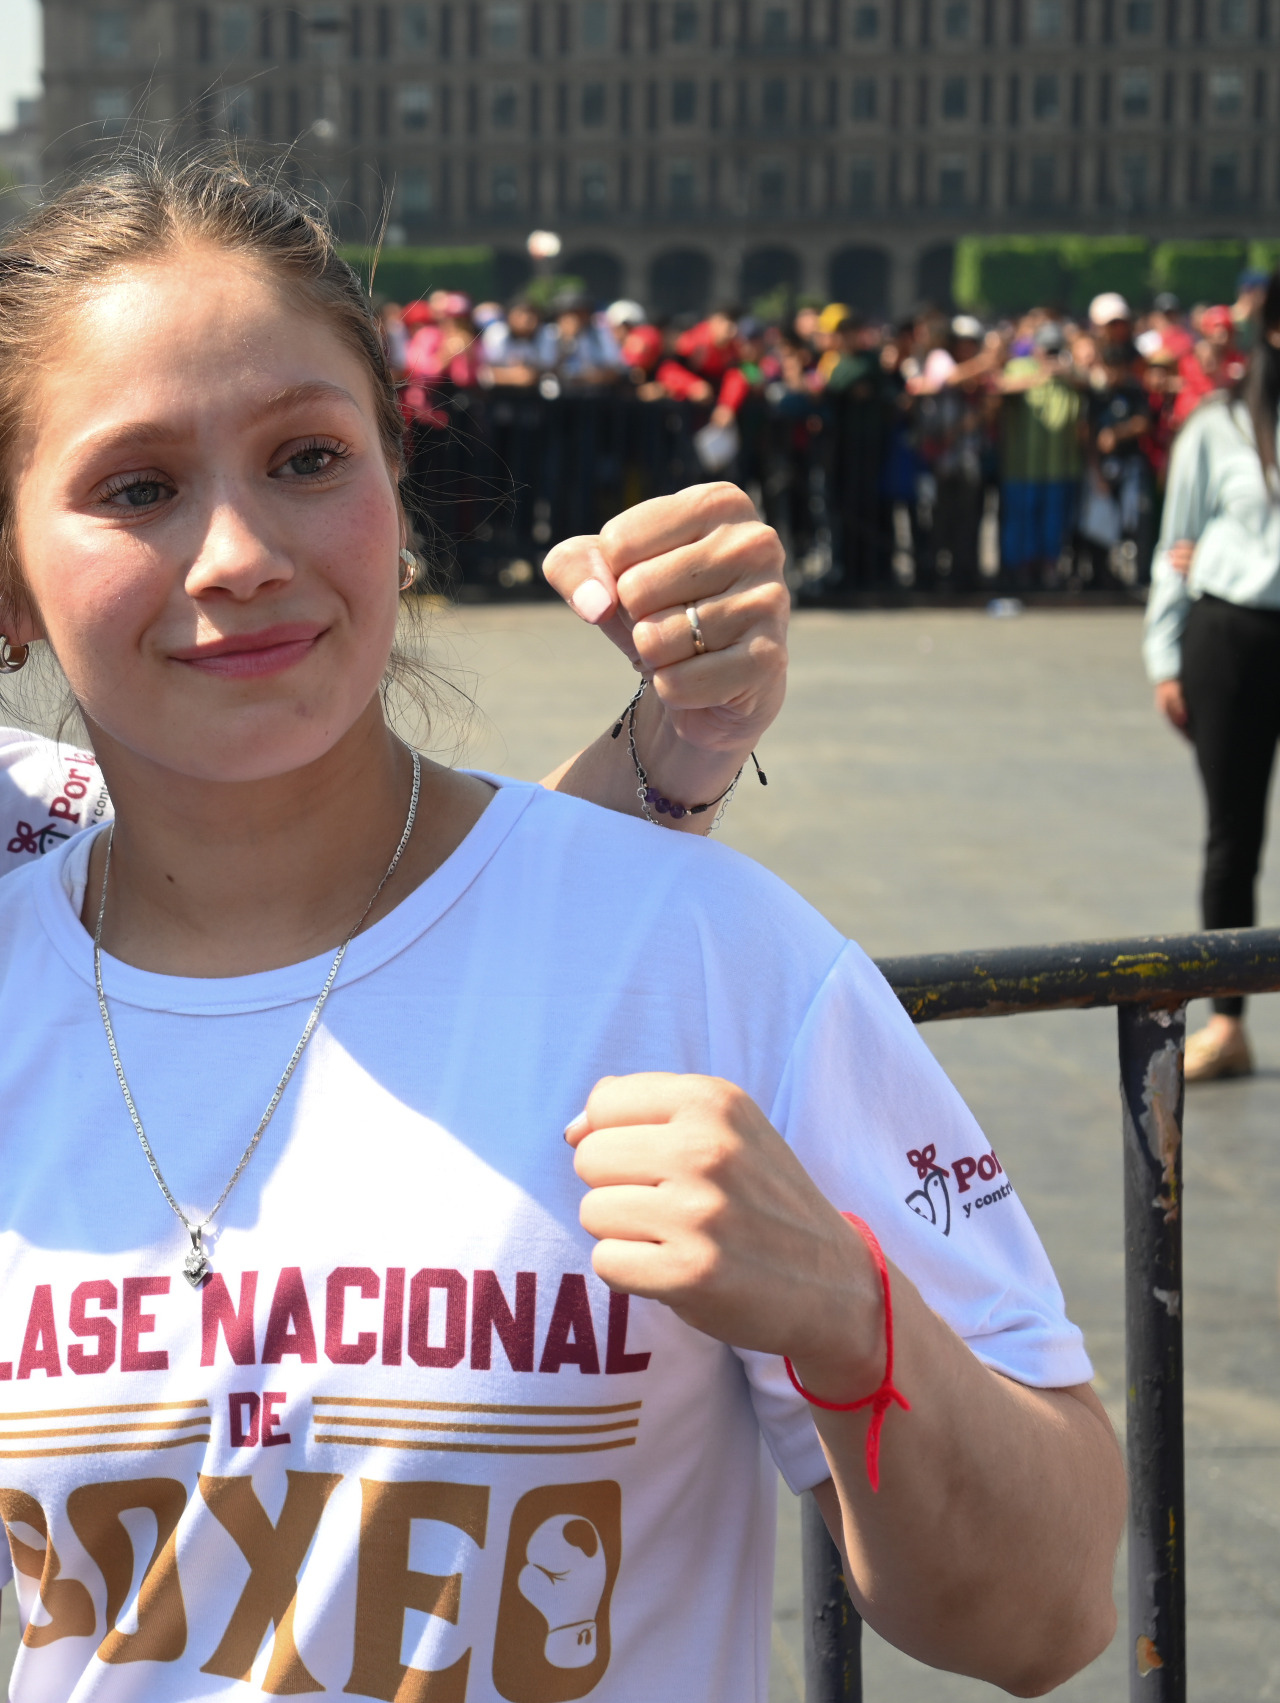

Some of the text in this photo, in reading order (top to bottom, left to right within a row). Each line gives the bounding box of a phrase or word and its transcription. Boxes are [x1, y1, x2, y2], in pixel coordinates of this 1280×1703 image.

[49, 768, 91, 824] Por
[963, 1202, 971, 1218] y
[199, 1266, 651, 1375] NACIONAL
[228, 1391, 291, 1448] DE
